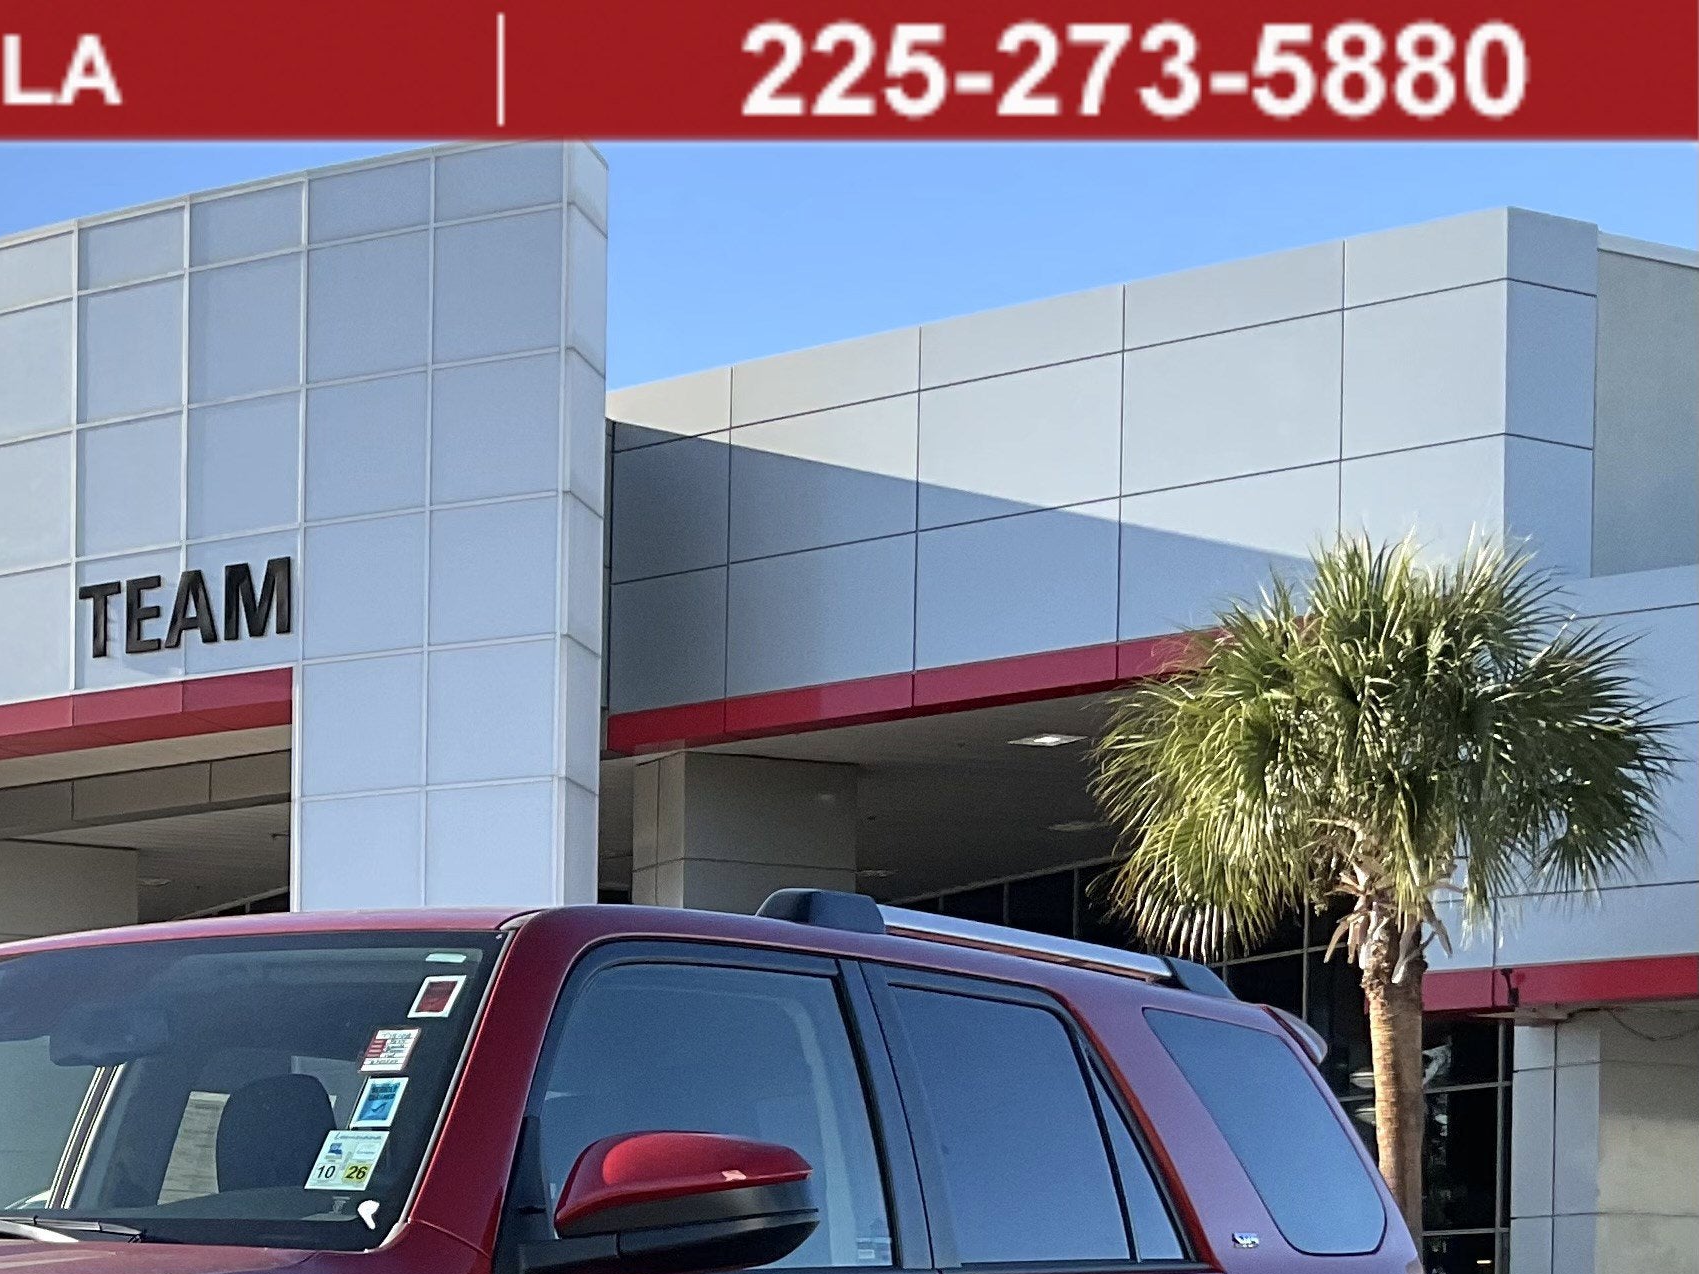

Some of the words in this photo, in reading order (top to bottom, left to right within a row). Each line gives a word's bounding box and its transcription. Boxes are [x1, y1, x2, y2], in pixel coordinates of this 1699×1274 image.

[78, 556, 293, 659] TEAM
[317, 1165, 336, 1179] 10
[345, 1165, 368, 1180] 26
